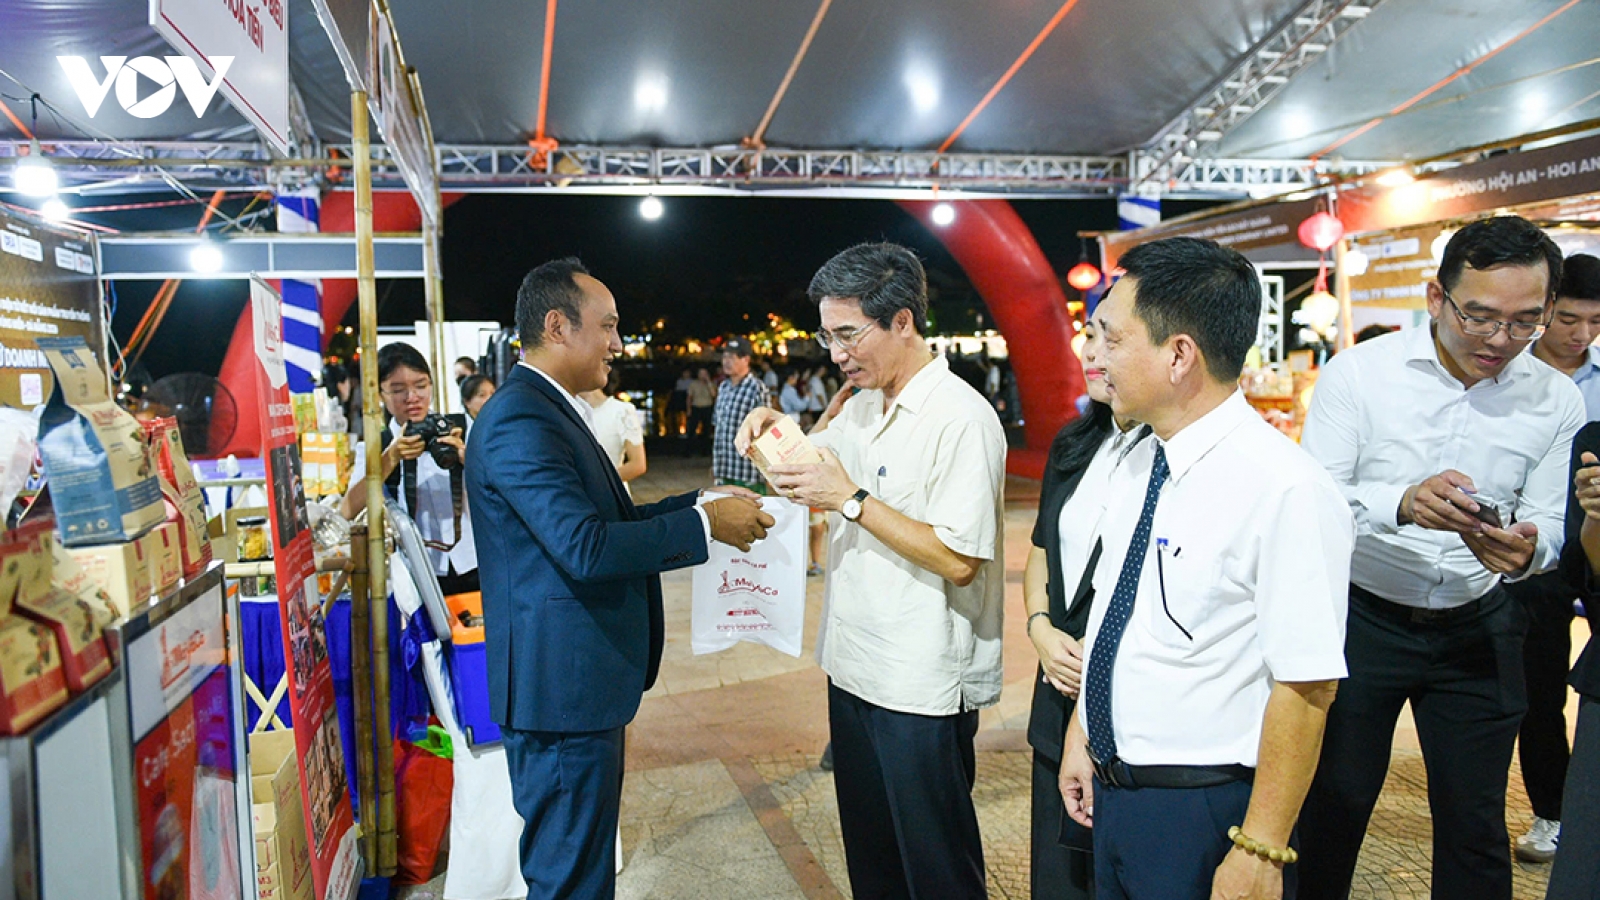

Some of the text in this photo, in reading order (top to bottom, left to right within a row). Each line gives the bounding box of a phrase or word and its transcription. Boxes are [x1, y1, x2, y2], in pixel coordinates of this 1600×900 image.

[1488, 170, 1514, 193] HỘI
[1516, 168, 1538, 185] AN
[1547, 160, 1577, 179] HOI
[1578, 155, 1600, 174] AN
[5, 347, 38, 368] DOANH
